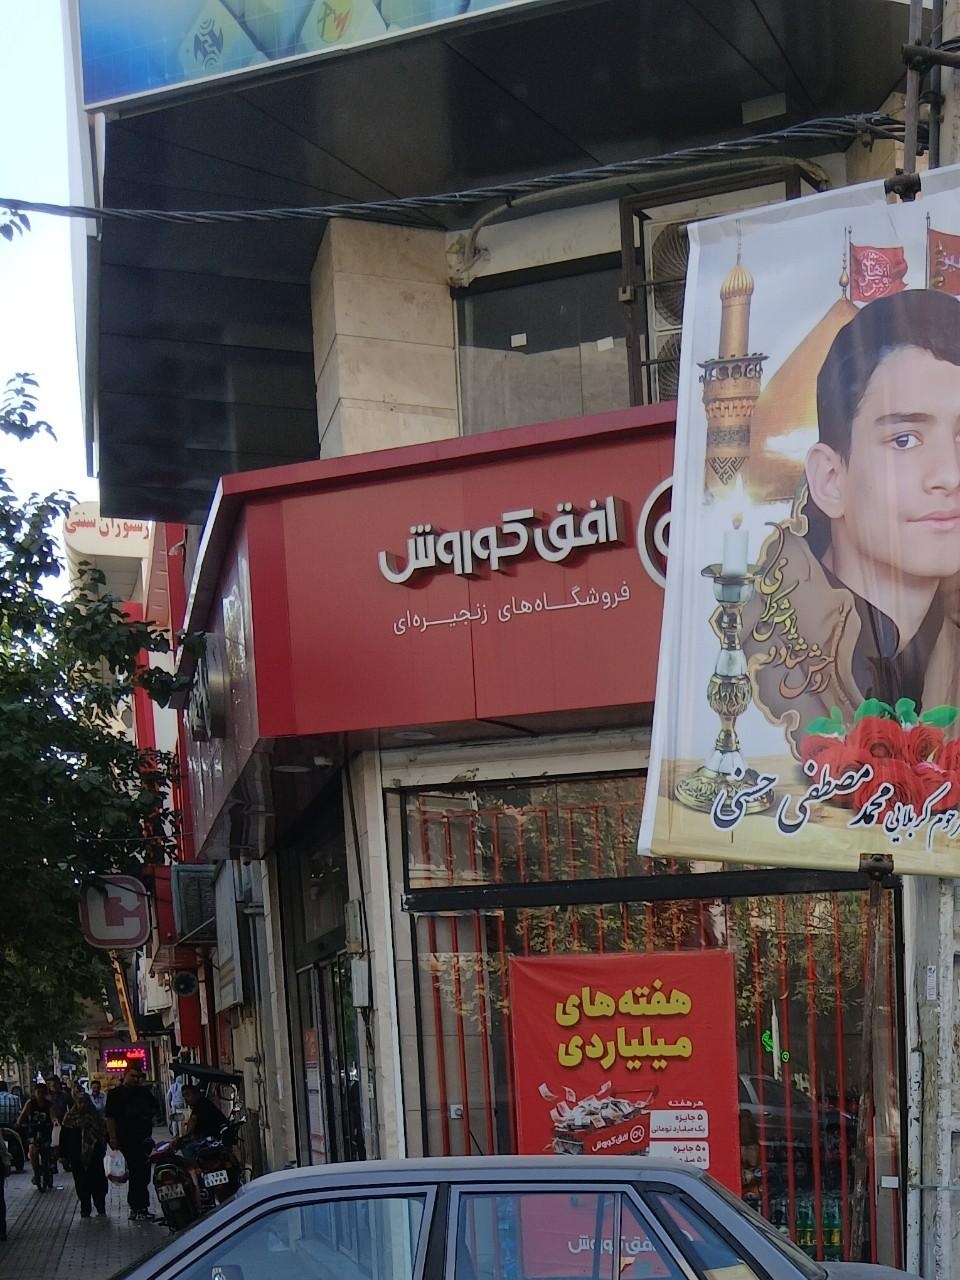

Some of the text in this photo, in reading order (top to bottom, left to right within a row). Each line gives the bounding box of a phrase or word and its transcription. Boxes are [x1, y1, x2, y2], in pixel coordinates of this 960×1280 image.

[378, 507, 535, 584] کوروش
[533, 496, 620, 563] افق
[711, 766, 779, 830] حسنی
[776, 760, 873, 835] مصطفی
[851, 782, 895, 828] محمد
[558, 1026, 693, 1070] میلیاردی
[667, 1098, 704, 1109] هر هفته
[675, 1113, 696, 1123] جایزه
[673, 1144, 694, 1154] جایزه
